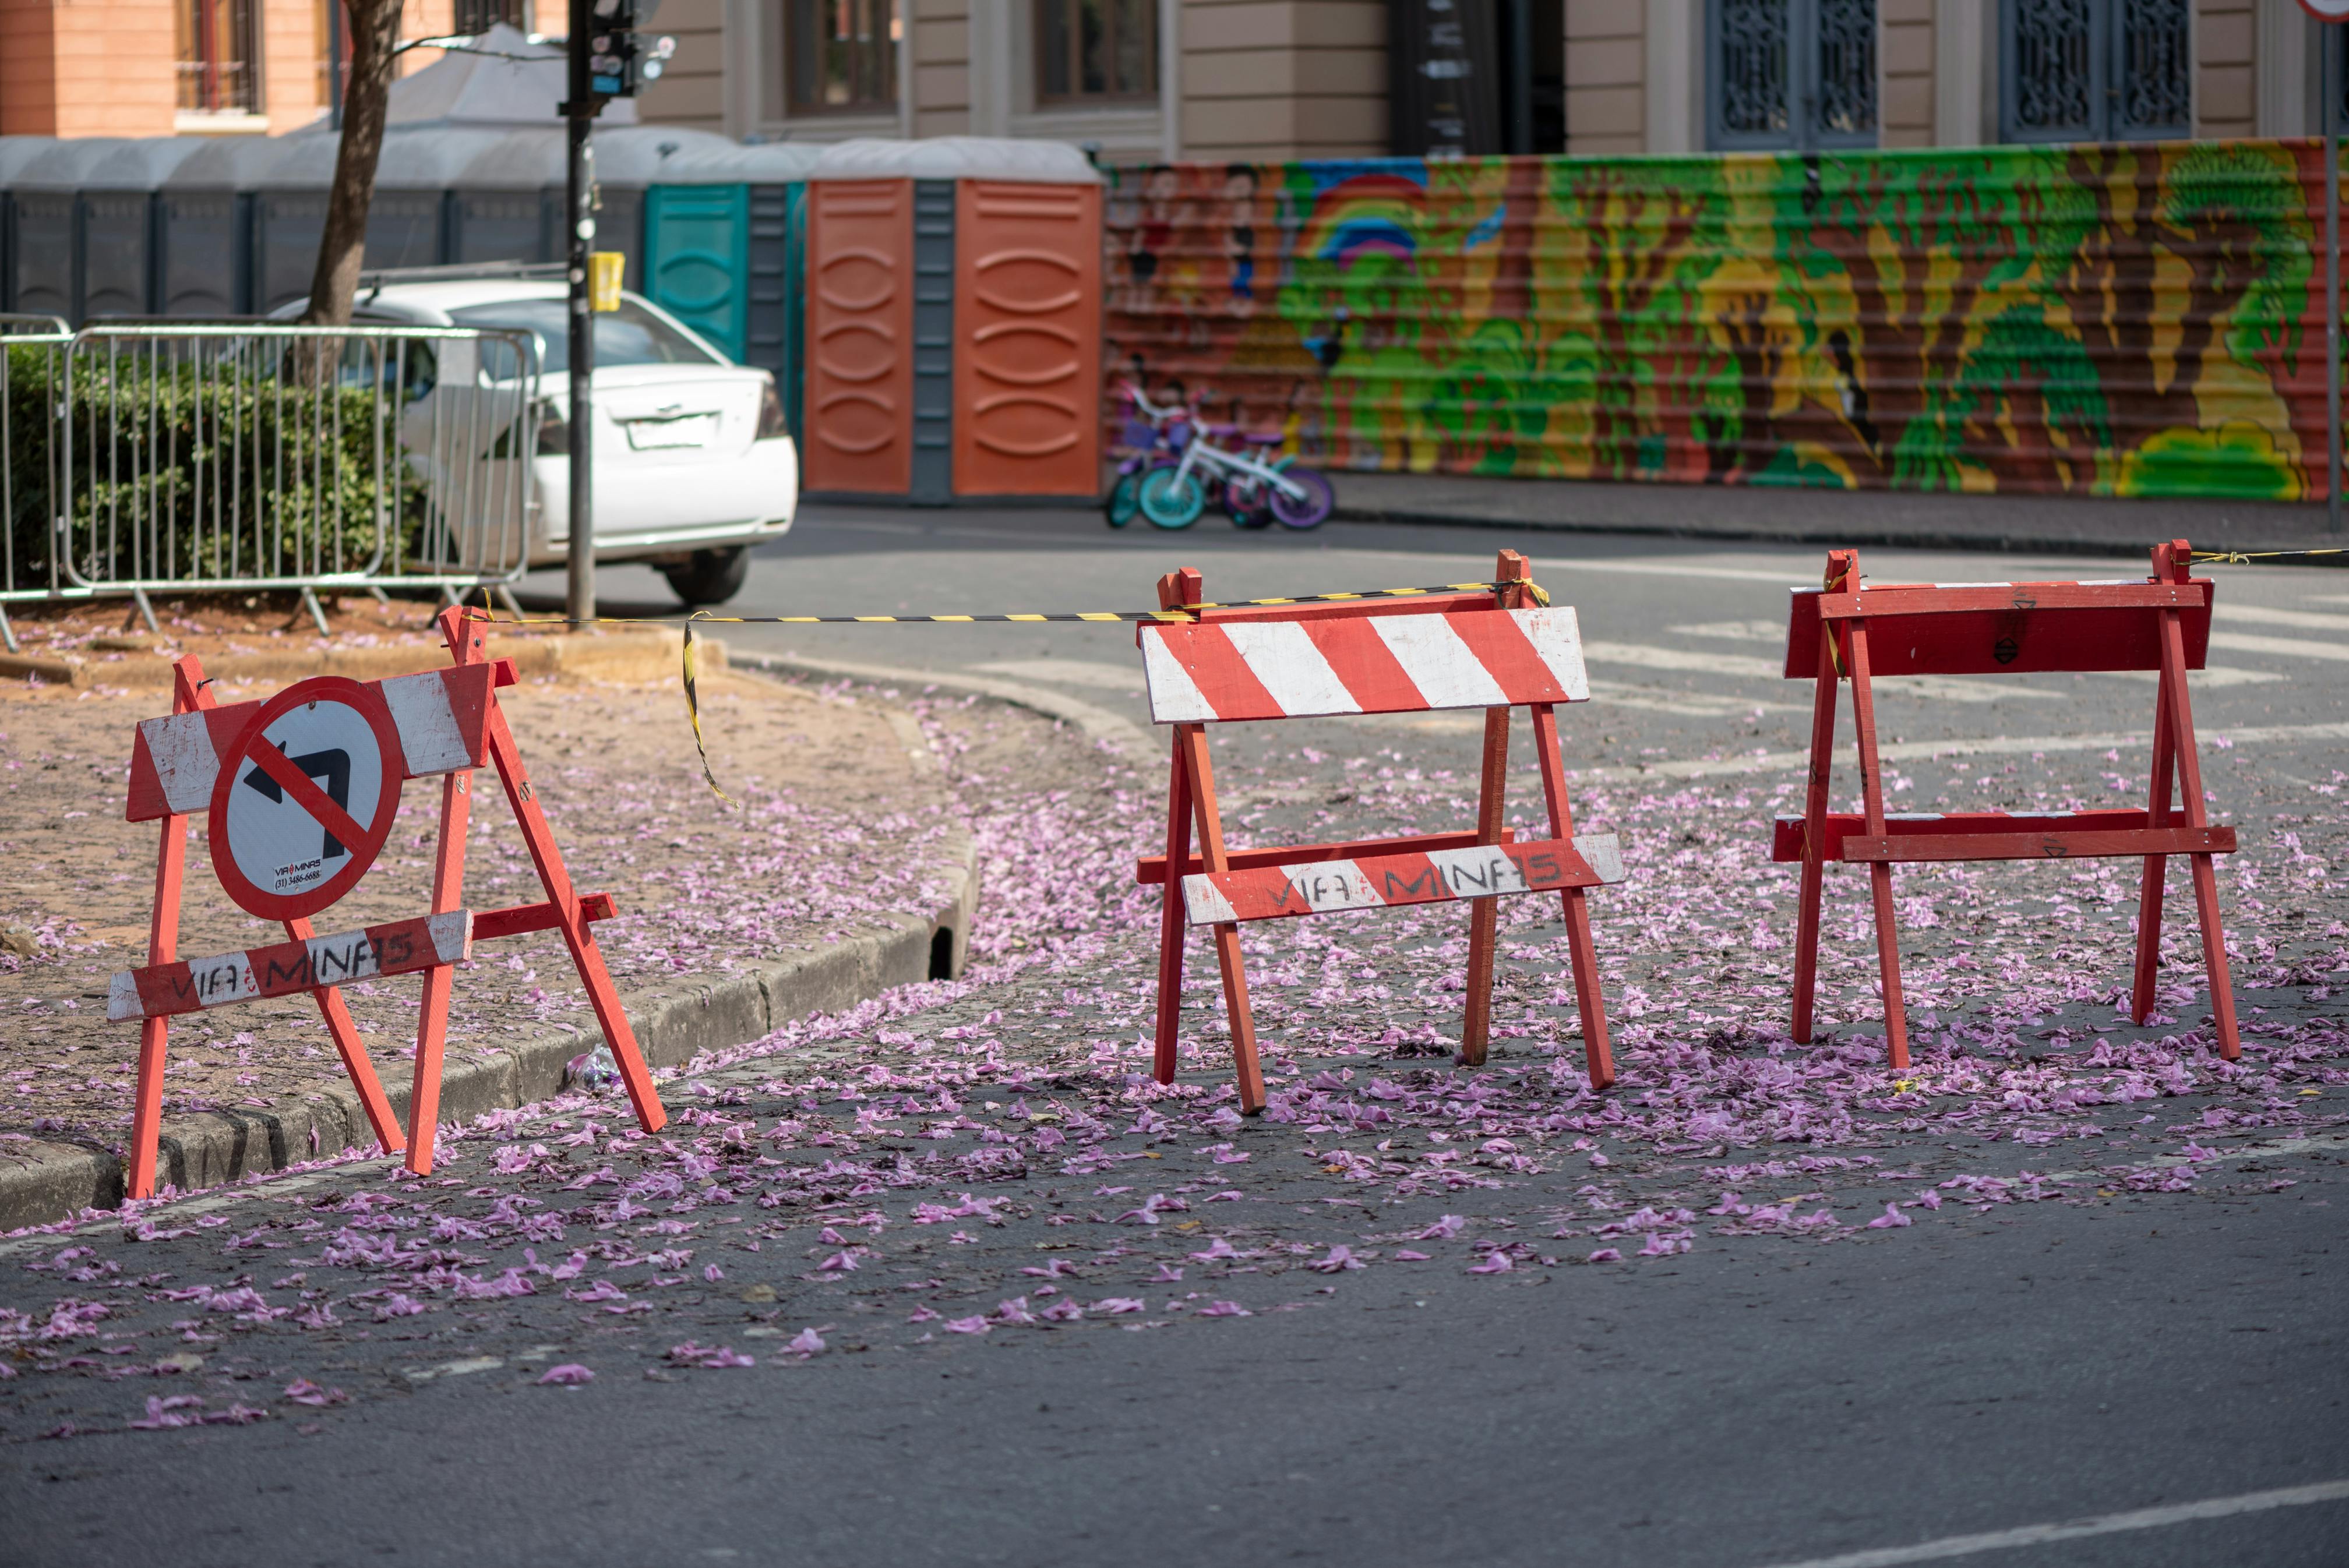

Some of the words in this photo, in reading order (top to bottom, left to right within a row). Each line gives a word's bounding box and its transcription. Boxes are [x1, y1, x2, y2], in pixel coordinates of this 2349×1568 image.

[275, 867, 289, 876] VIA
[295, 859, 321, 872] MINAS
[276, 878, 287, 890] (31)
[288, 870, 320, 885] 3486-6688
[1267, 874, 1350, 906] VIA
[1384, 854, 1561, 898] MINAS
[171, 965, 238, 1000] VIA
[266, 931, 414, 988] MINAS
